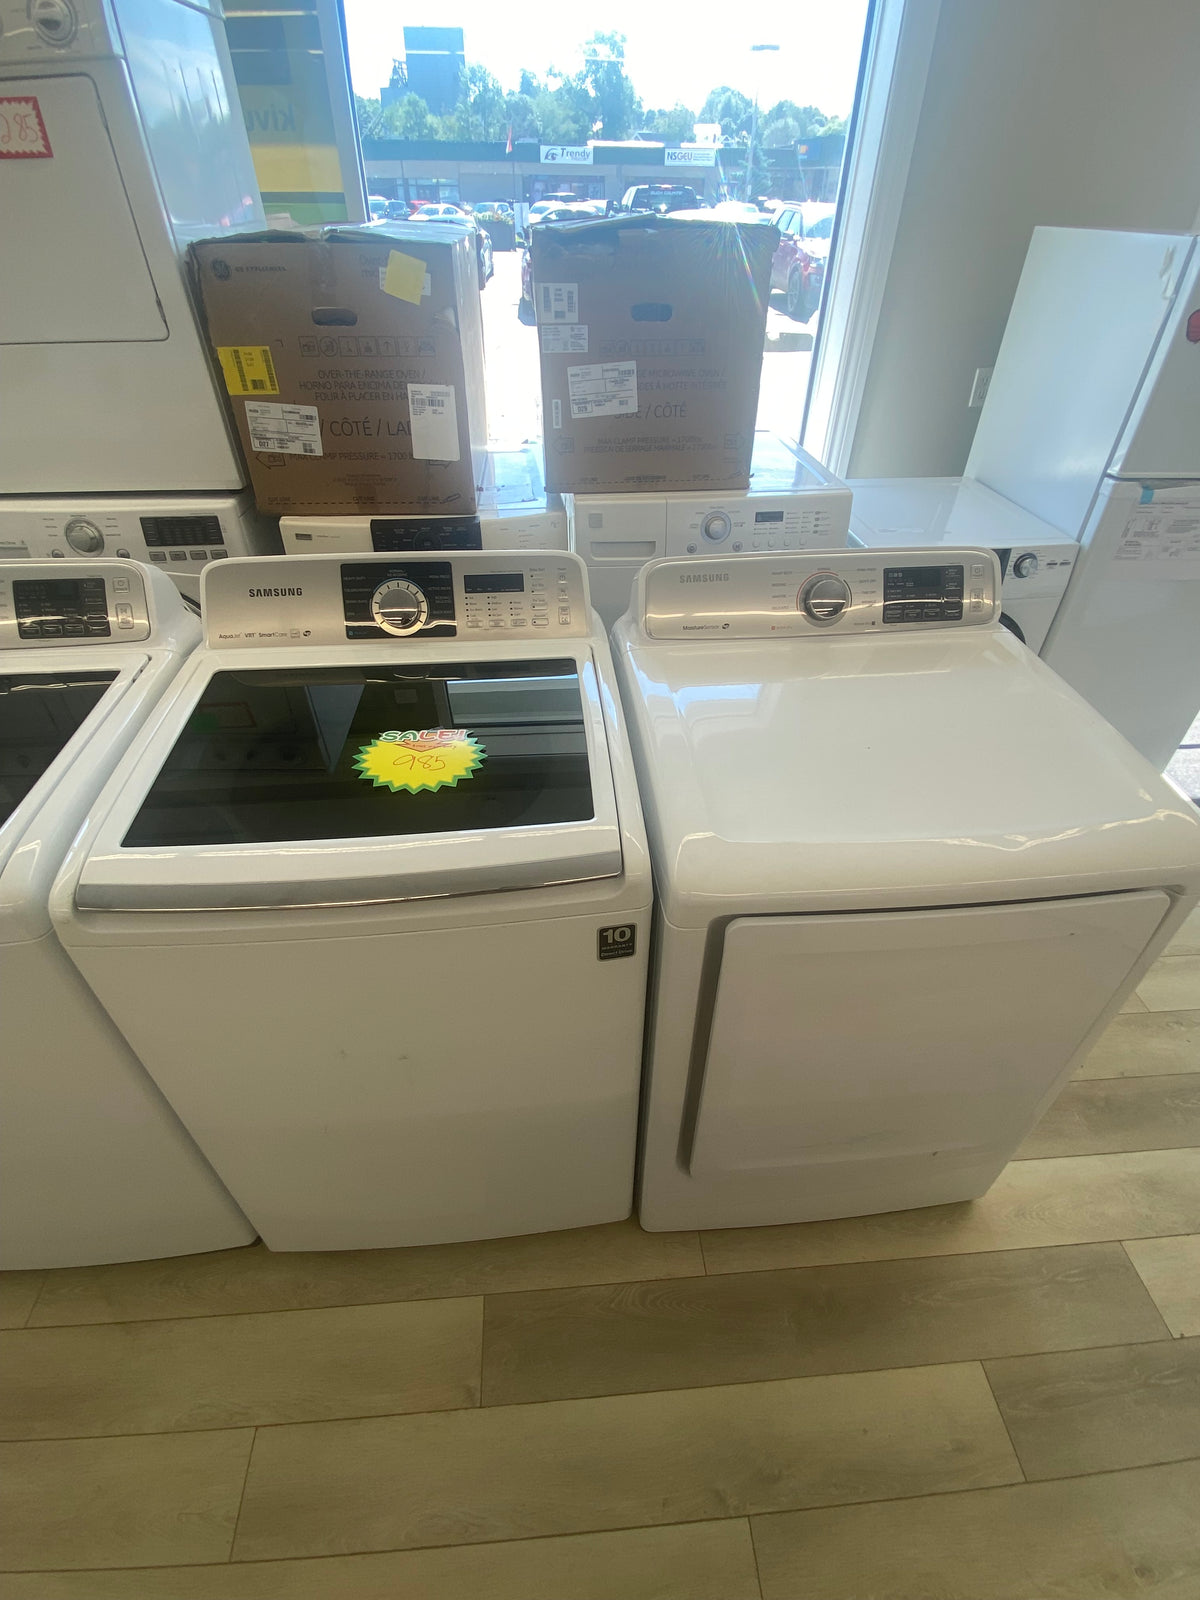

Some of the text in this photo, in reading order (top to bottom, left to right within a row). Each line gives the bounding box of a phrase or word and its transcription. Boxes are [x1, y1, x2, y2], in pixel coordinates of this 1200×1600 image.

[561, 148, 590, 159] Trendy
[654, 401, 687, 418] CÔTÉ
[330, 416, 372, 436] CÔTÉ
[679, 572, 729, 584] SAMSUNG
[248, 587, 303, 598] SAMSUNG
[392, 754, 446, 772] 985
[602, 927, 632, 944] 10
